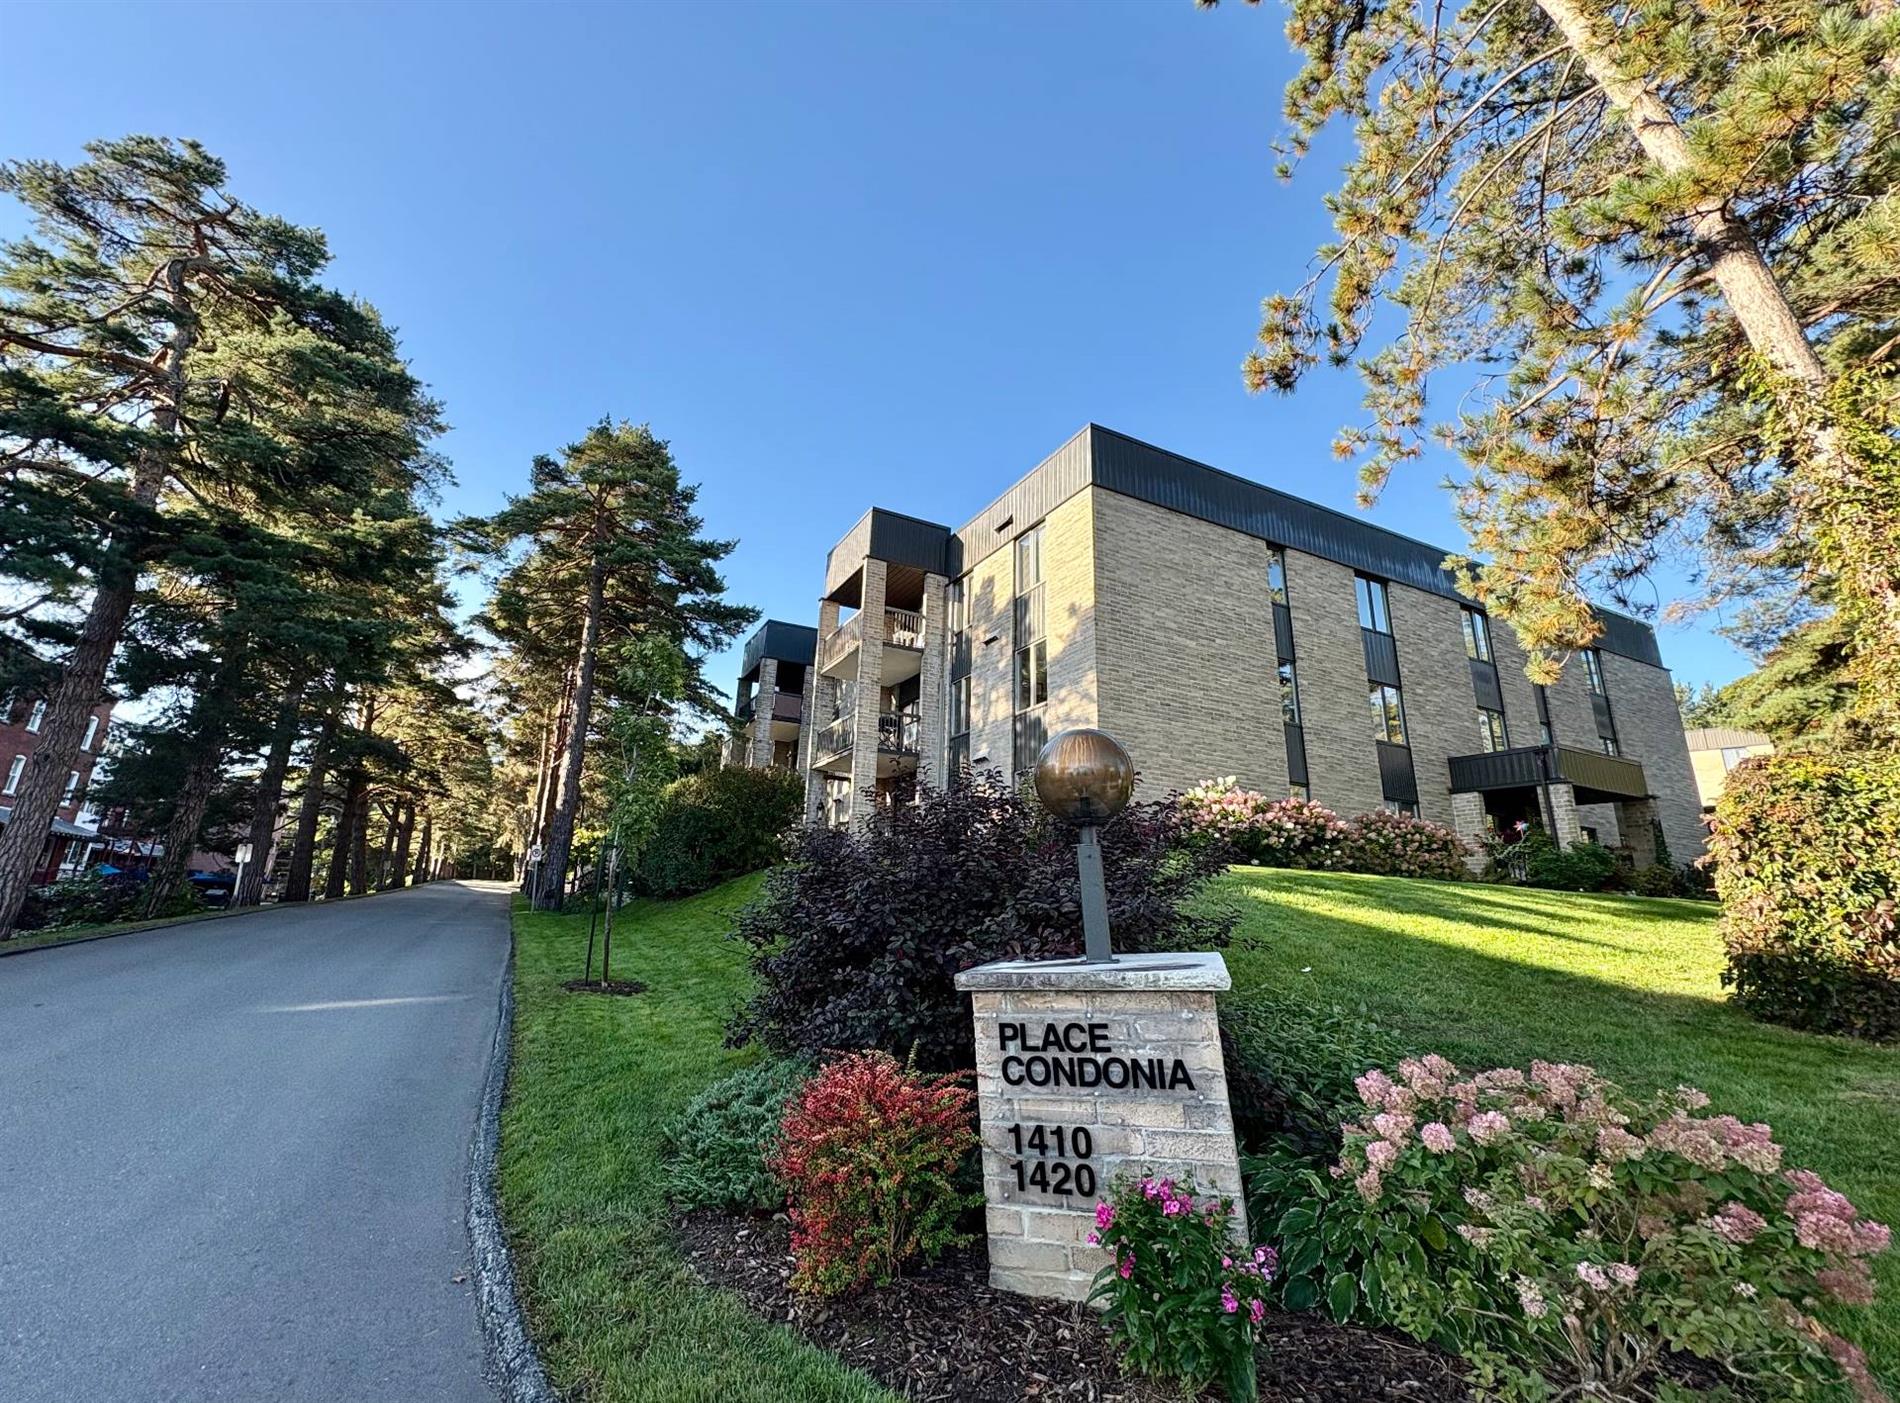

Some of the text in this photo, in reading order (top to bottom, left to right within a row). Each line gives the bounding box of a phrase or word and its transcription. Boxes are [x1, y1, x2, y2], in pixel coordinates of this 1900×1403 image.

[998, 1023, 1112, 1053] PLACE
[1001, 1055, 1196, 1091] CONDONIA
[1008, 1123, 1093, 1159] 1410
[1010, 1160, 1096, 1198] 1420
